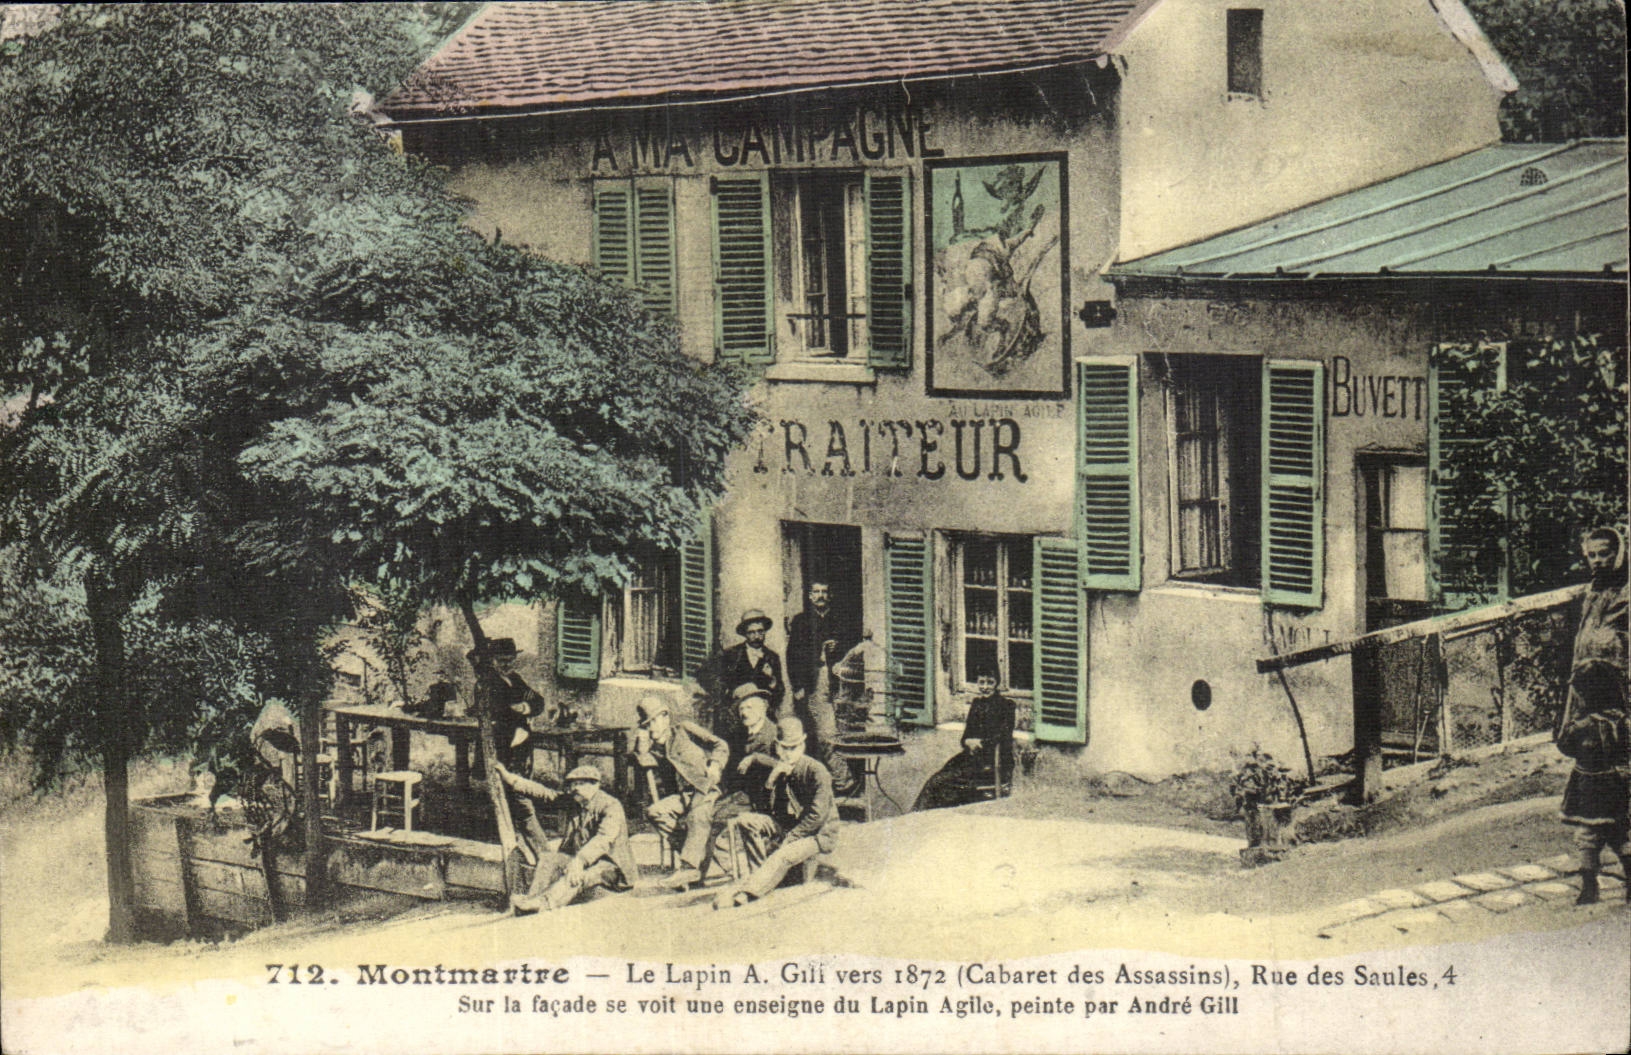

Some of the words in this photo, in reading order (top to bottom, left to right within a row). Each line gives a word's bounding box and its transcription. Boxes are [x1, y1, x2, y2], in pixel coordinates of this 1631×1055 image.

[631, 128, 694, 169] MA
[713, 104, 945, 167] CAMPAGNE
[752, 417, 1029, 483] TRAITEUR
